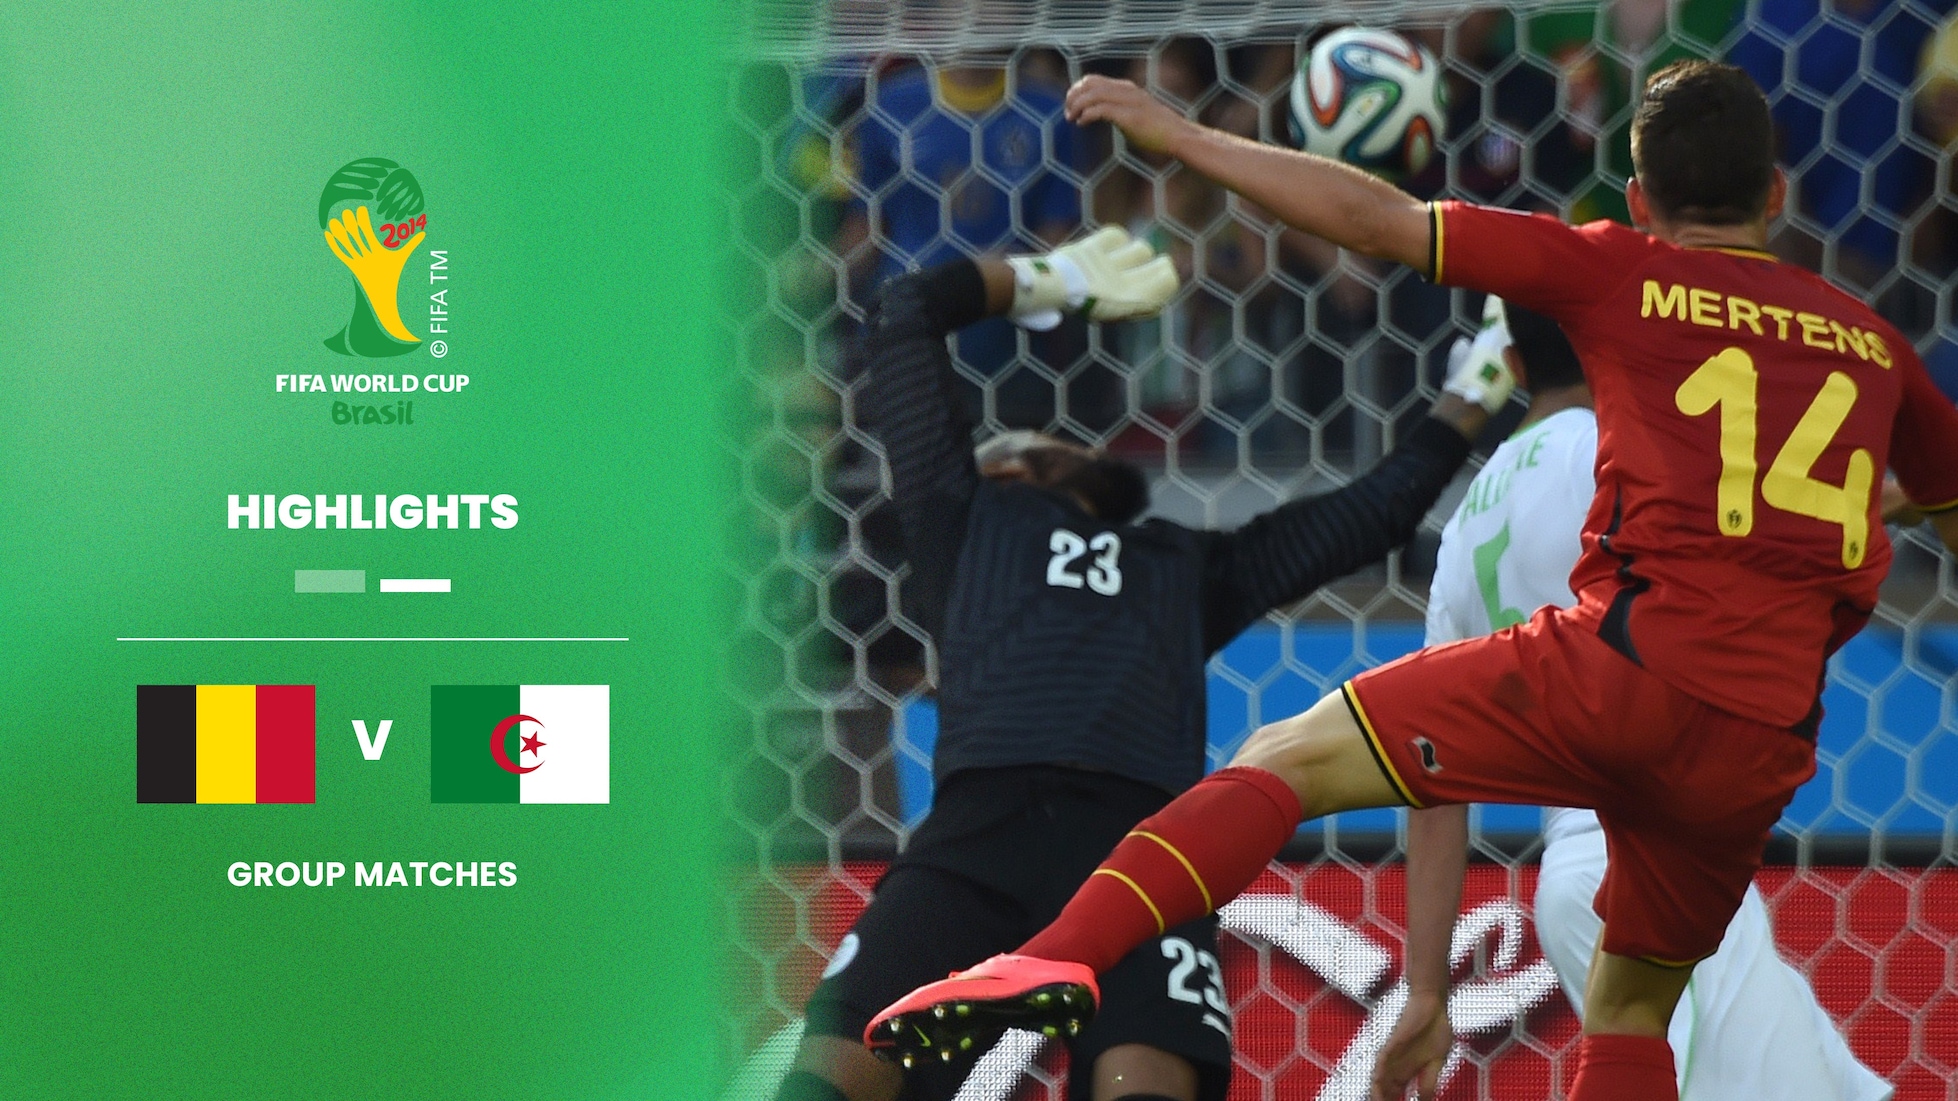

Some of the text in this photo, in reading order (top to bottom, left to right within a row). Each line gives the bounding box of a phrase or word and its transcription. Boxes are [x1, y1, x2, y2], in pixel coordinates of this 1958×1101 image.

[1640, 279, 1893, 370] MERTENS
[1674, 346, 1874, 570] 14
[1046, 528, 1122, 597] 23
[1160, 936, 1229, 1016] 23
